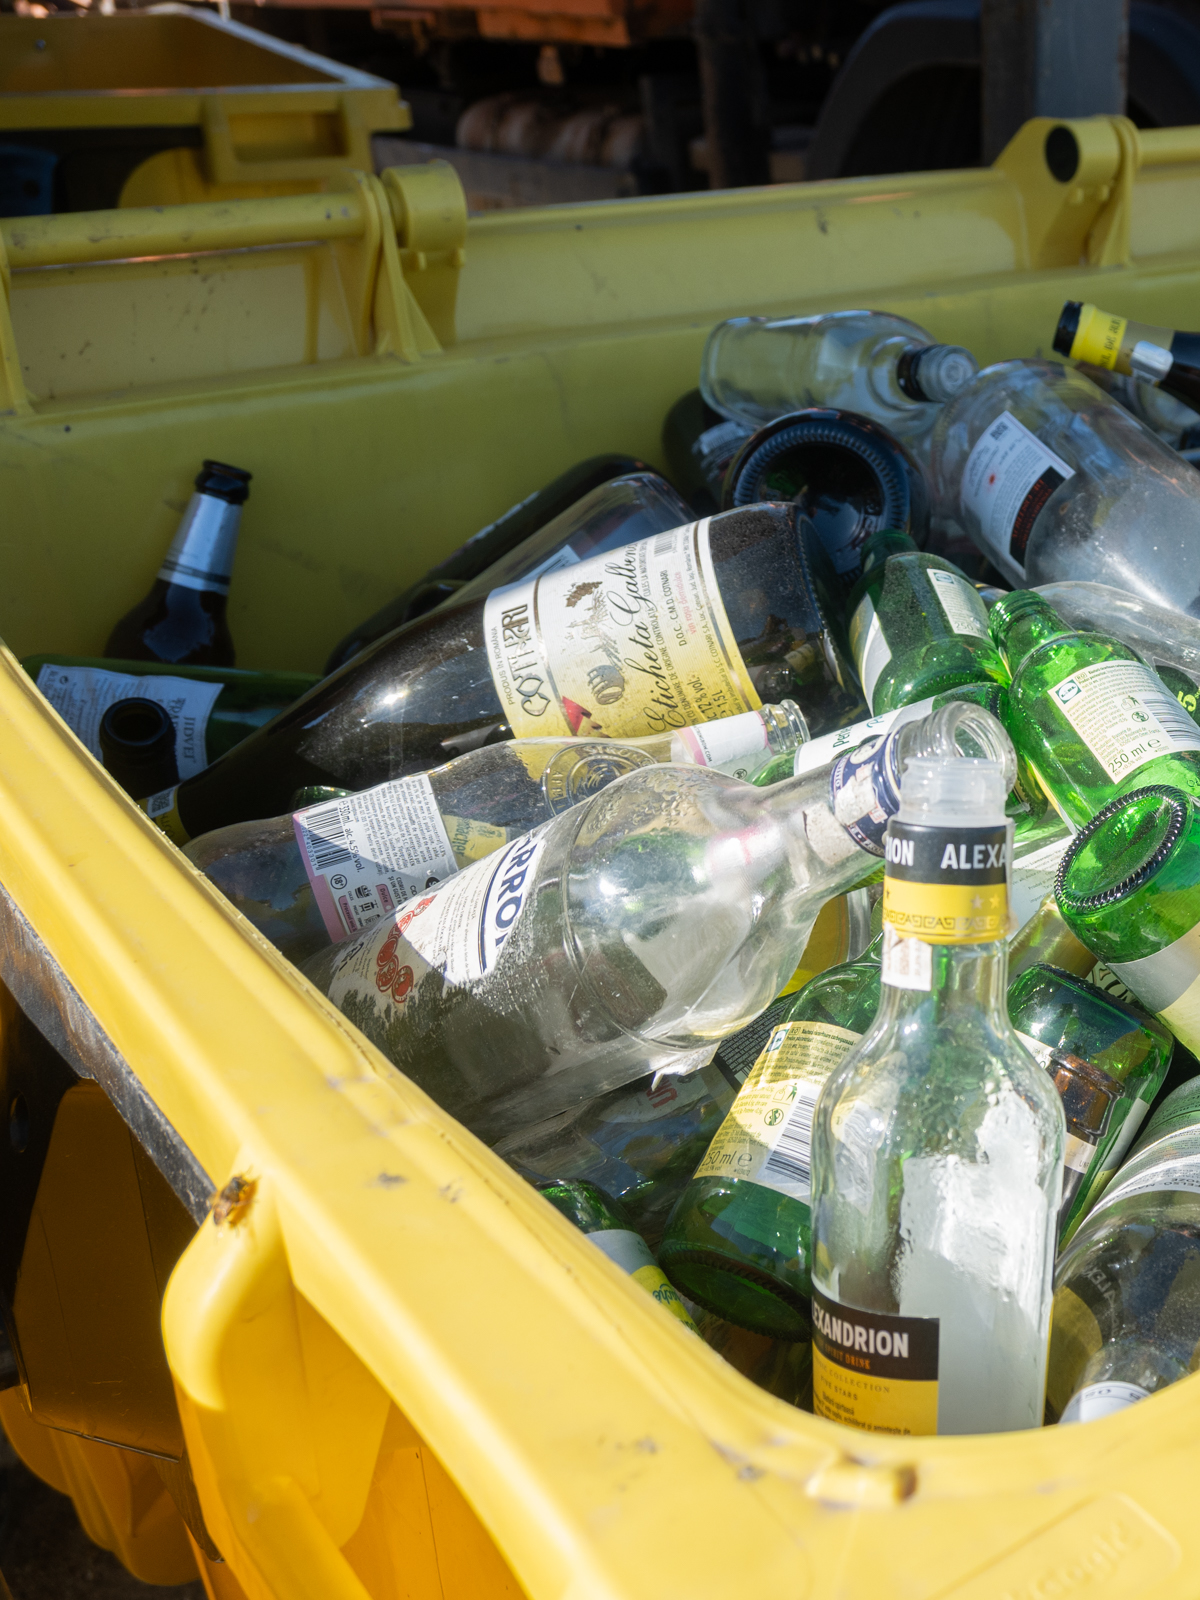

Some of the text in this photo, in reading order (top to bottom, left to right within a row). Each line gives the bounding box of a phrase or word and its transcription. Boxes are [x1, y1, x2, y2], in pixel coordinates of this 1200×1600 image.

[658, 569, 673, 596] COTNARI
[665, 597, 679, 620] C.M.D.
[672, 623, 686, 646] D.O.C.
[686, 620, 697, 634] vin
[704, 633, 718, 657] COTNARI
[659, 645, 674, 670] ORIGINE
[498, 669, 514, 705] PRODUS
[624, 619, 687, 732] Eticheta
[668, 671, 677, 680] DE
[693, 691, 708, 703] %
[697, 701, 713, 713] 12
[1179, 690, 1197, 713] 5
[1107, 742, 1147, 773] 250 ml
[353, 857, 365, 873] vol.
[379, 887, 389, 903] Dulce
[829, 1369, 891, 1394] COLLECTION
[834, 1384, 858, 1401] STARS
